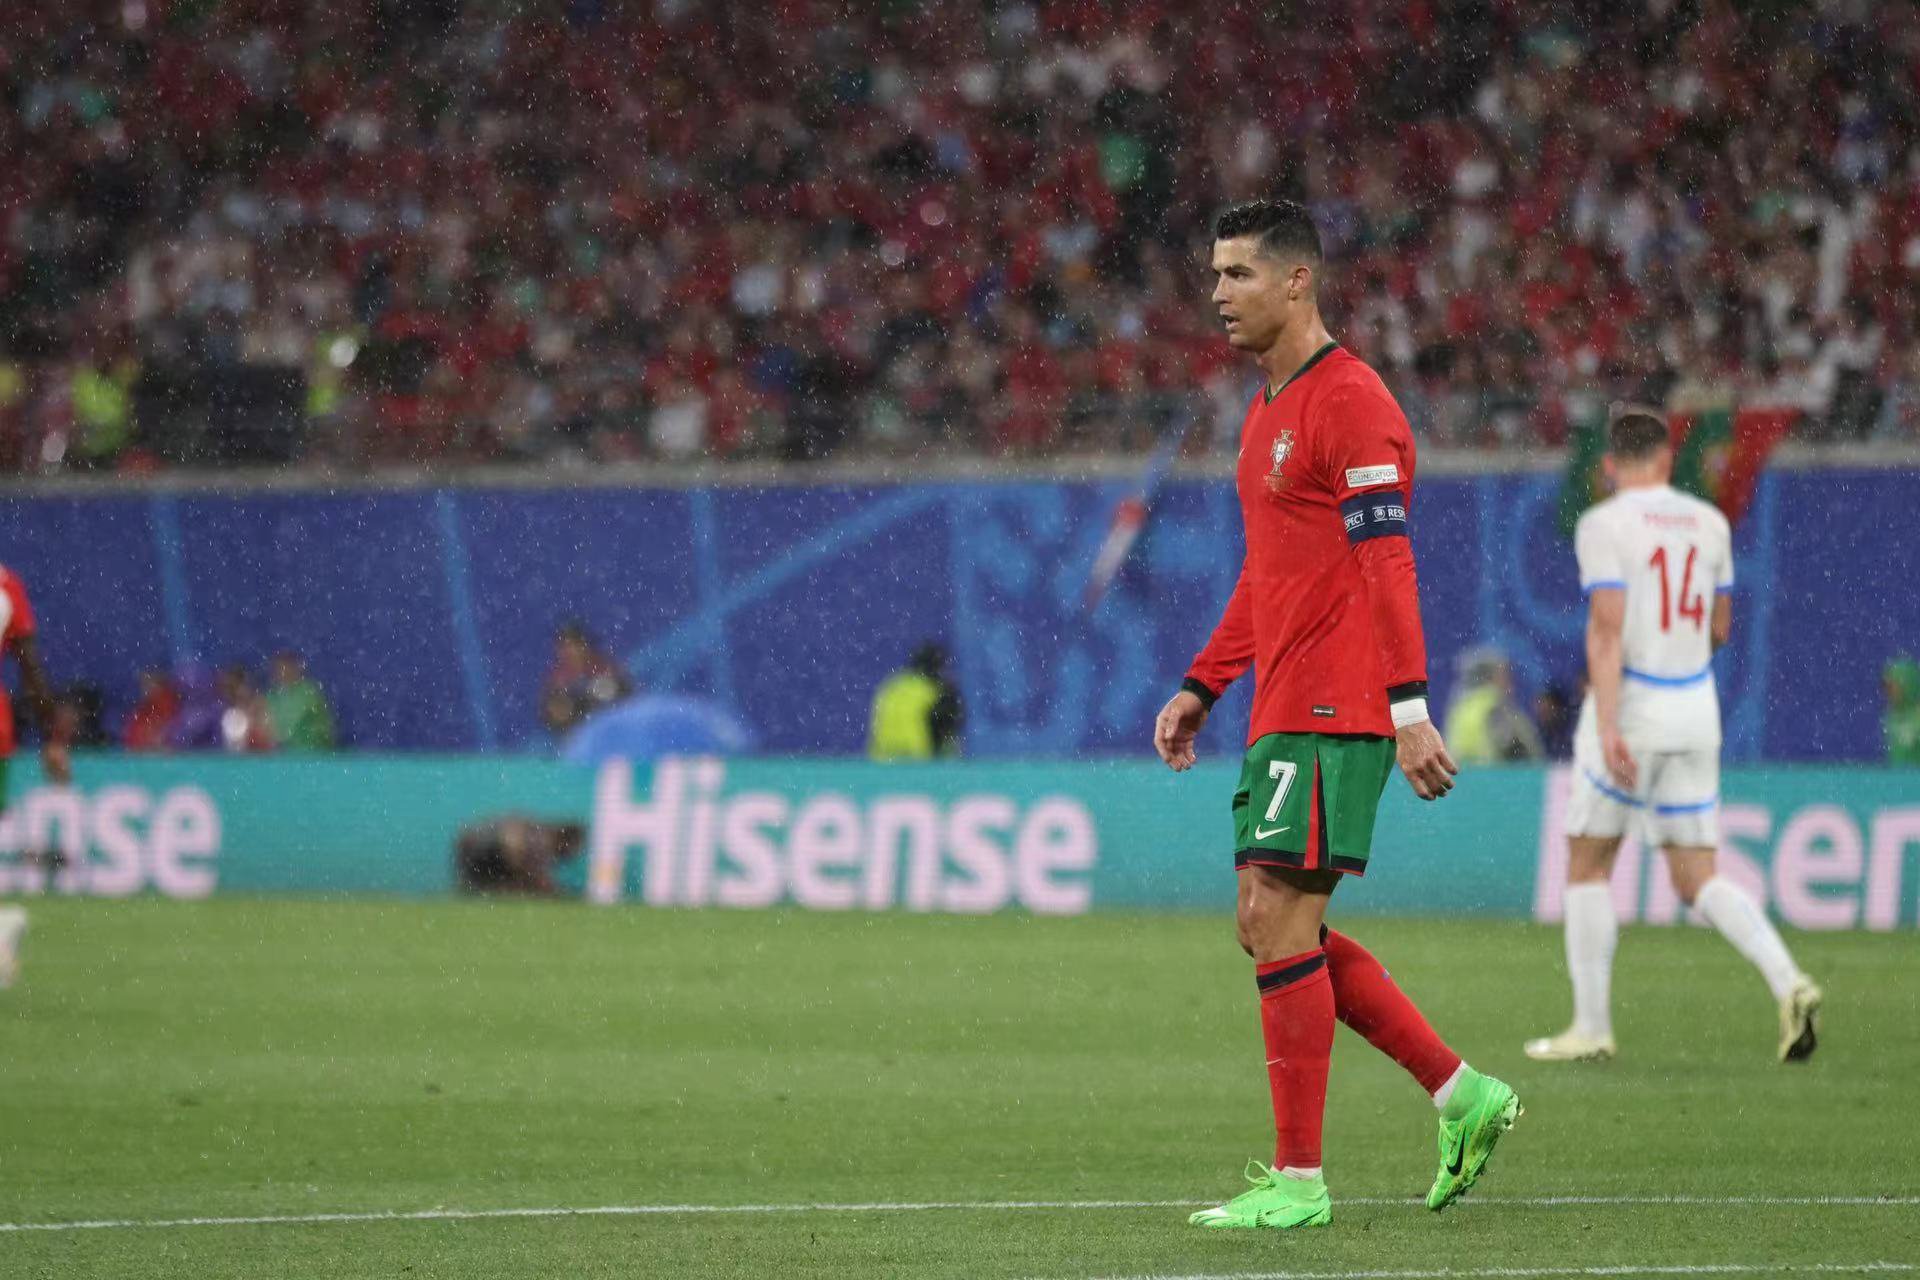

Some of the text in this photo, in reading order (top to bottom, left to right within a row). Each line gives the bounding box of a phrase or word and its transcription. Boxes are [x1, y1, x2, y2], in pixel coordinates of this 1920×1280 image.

[1348, 471, 1396, 482] FOUNDATION
[1649, 546, 1704, 633] 14
[1264, 760, 1297, 822] 7
[588, 757, 1097, 914] Hisense
